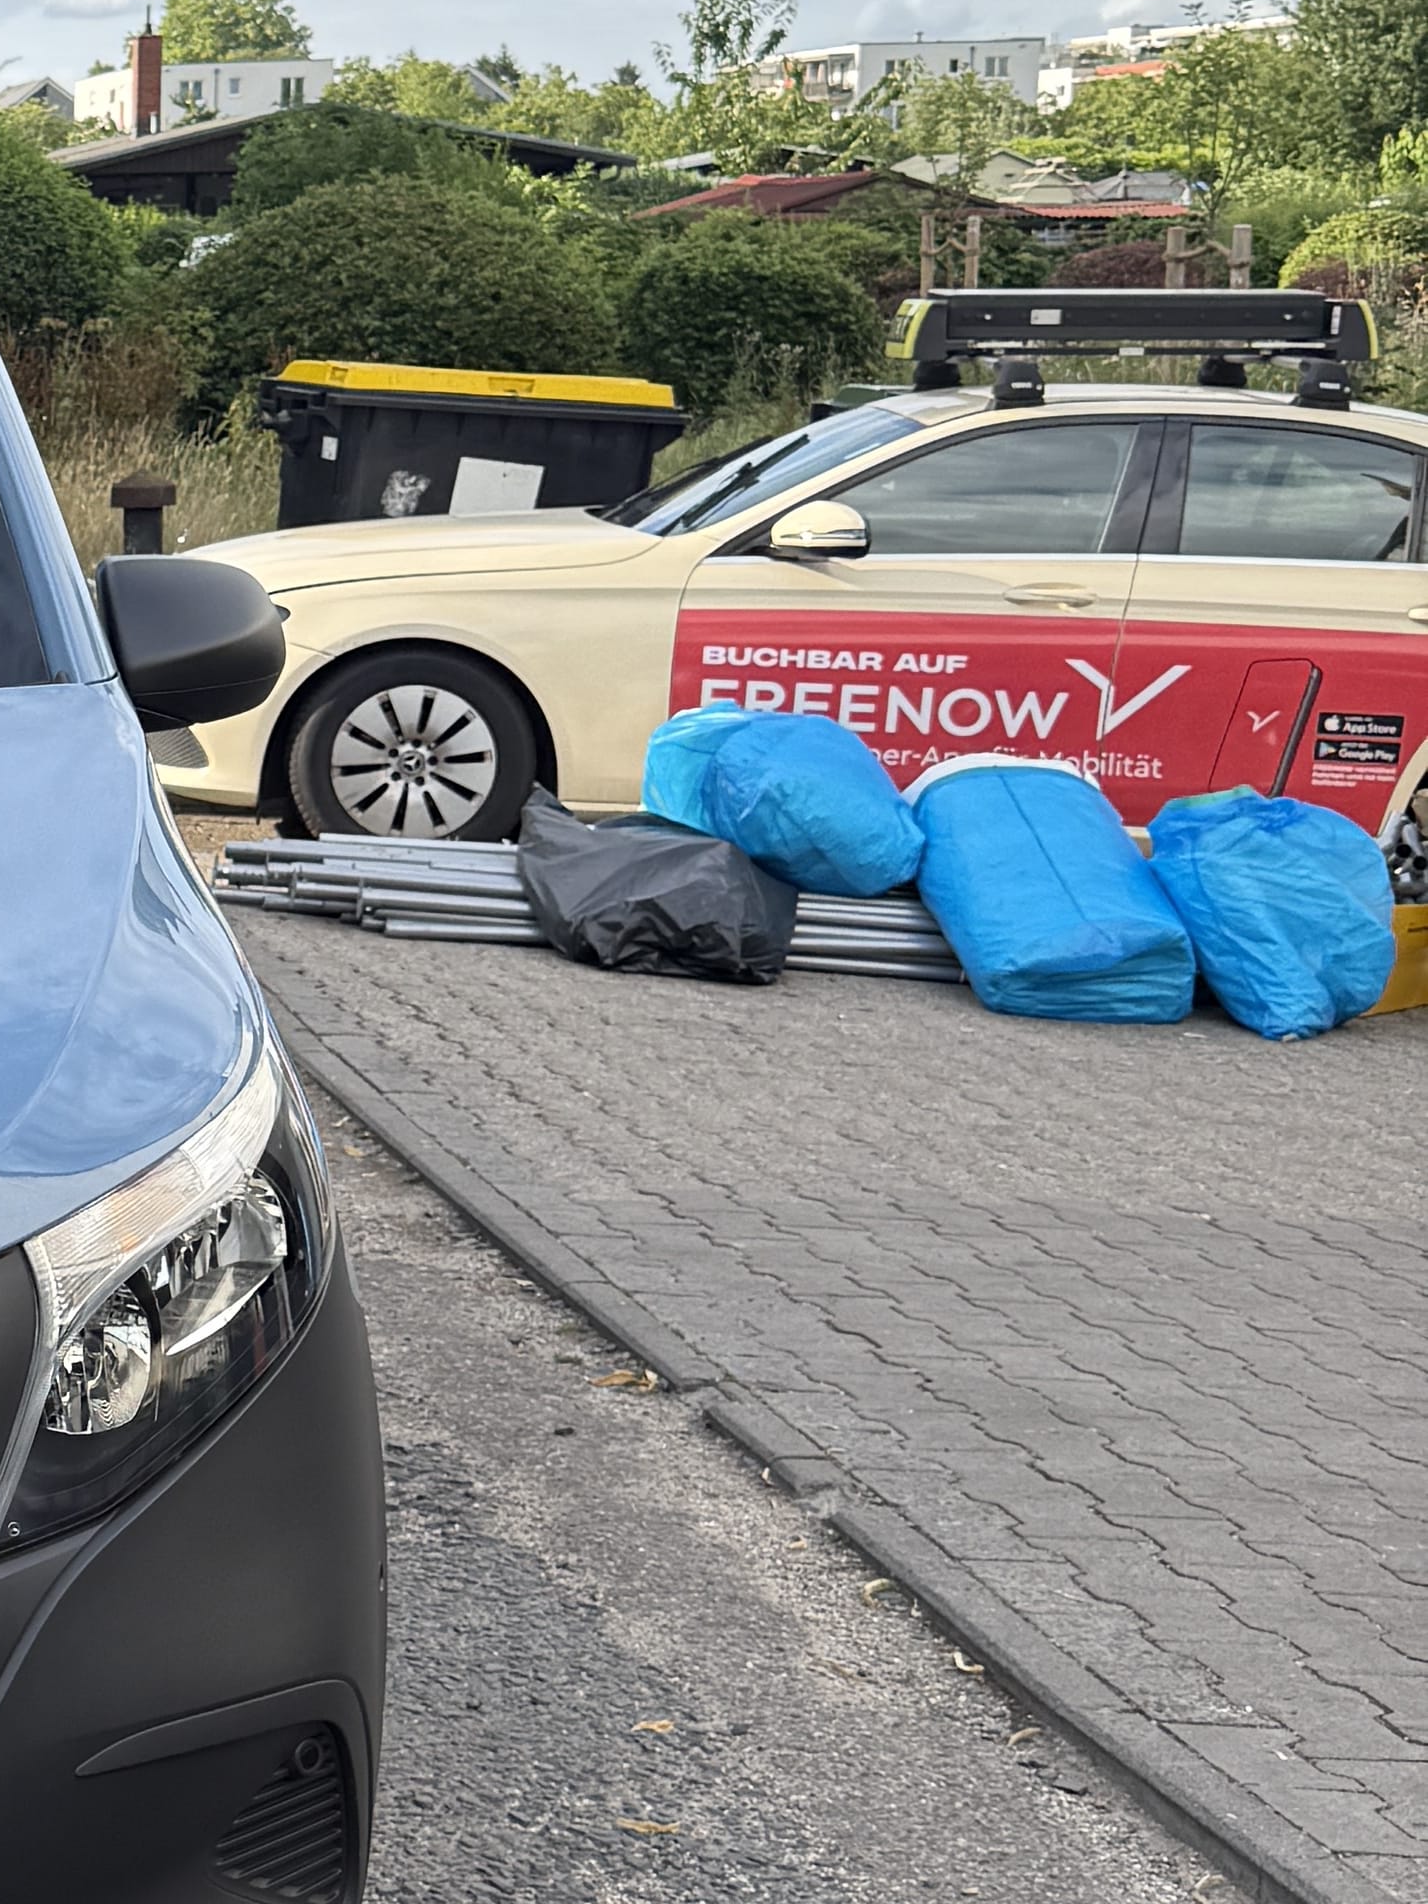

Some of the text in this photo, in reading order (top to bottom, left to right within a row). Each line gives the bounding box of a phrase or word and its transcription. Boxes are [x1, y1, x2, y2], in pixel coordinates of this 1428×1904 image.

[702, 645, 968, 674] BUCHBAR AUF
[1343, 722, 1397, 734] App Store
[1338, 748, 1396, 762] Google Play
